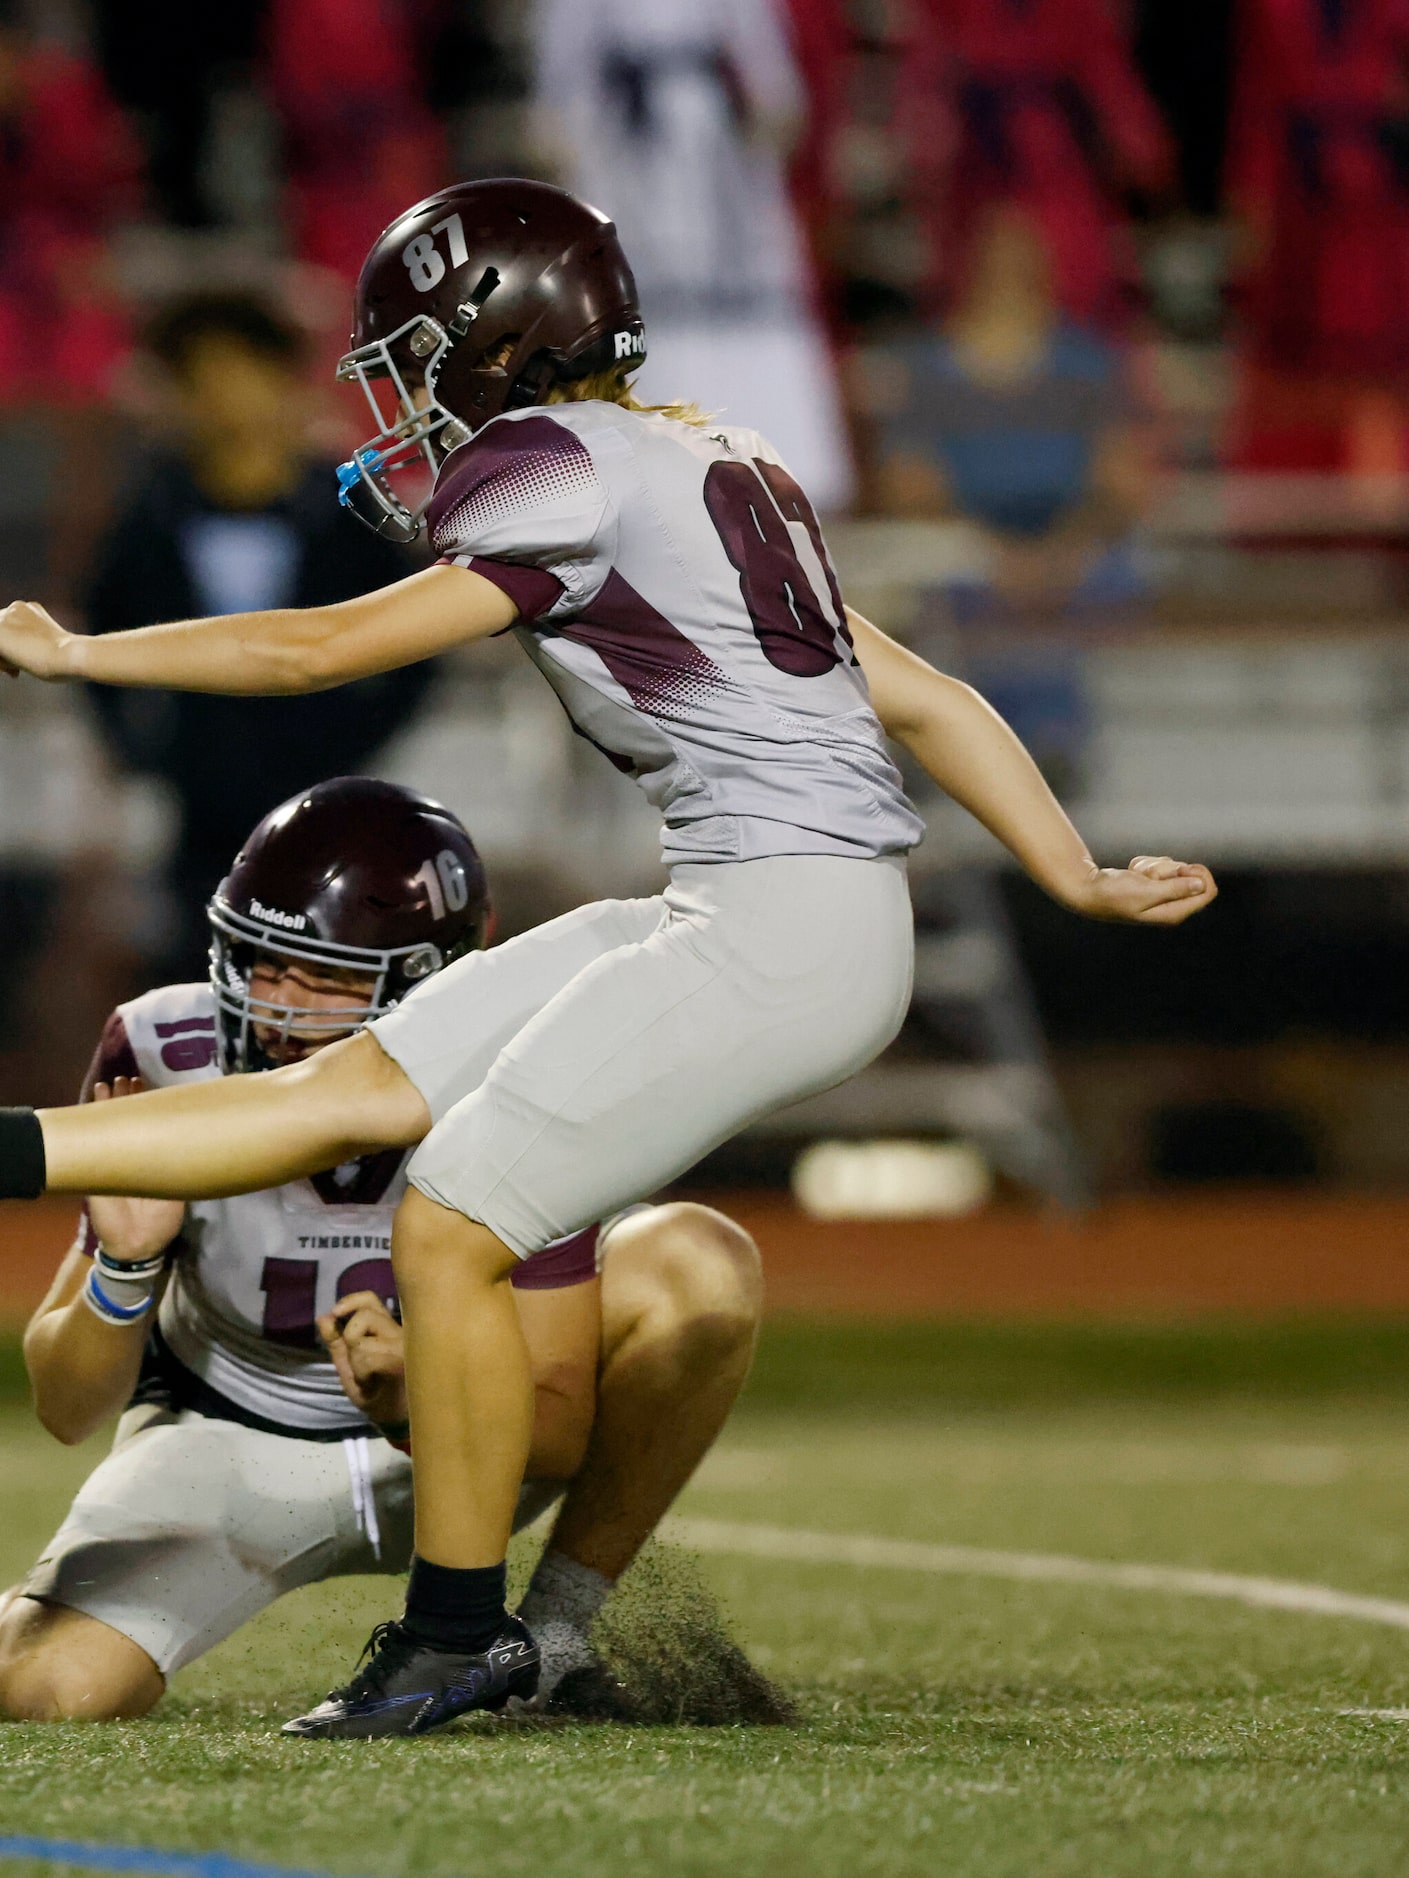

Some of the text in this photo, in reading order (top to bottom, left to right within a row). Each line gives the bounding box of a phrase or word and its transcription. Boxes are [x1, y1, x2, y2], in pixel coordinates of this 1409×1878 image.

[402, 212, 470, 292] 87
[703, 457, 859, 677] 87
[249, 898, 306, 930] Riddell
[408, 849, 468, 920] 16
